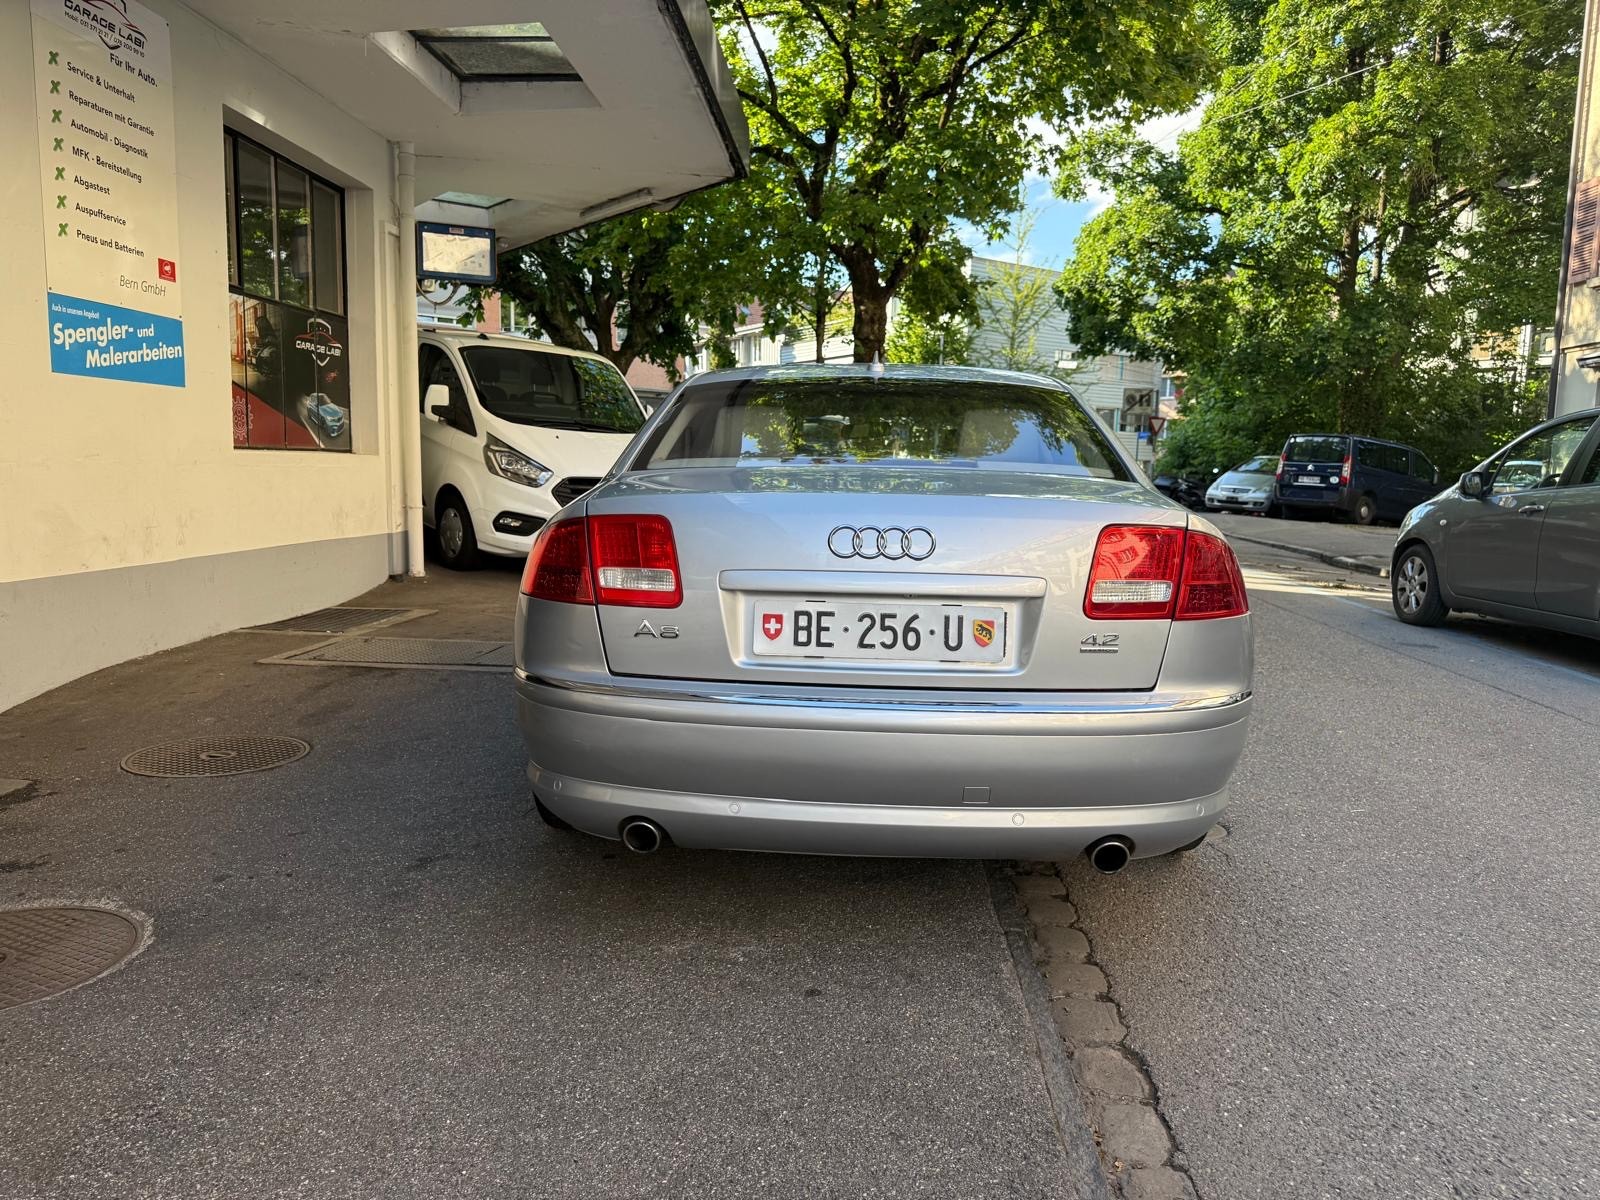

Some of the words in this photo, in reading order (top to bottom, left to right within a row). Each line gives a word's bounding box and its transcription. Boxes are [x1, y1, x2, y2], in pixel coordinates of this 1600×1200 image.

[64, 0, 116, 33] GARAGE
[118, 27, 145, 49] LABI
[80, 19, 89, 28] 031
[67, 61, 94, 82] Service
[96, 75, 101, 86] &
[103, 79, 135, 103] Unterhalt
[110, 52, 123, 67] Für
[125, 61, 135, 74] Ihr
[138, 69, 157, 87] Auto.
[69, 90, 113, 117] Reparaturen
[114, 113, 126, 124] mit
[127, 117, 154, 136] Garantie
[71, 119, 108, 142] Automobil
[114, 137, 148, 159] Diagnostik
[72, 146, 90, 161] MFK
[96, 155, 142, 183] Bereitstellung
[74, 175, 110, 195] Abgastest
[75, 202, 126, 226] Auspuffservice
[76, 229, 98, 244] Pneus
[99, 238, 113, 248] und
[114, 241, 144, 257] Batterien
[119, 275, 138, 290] Bern
[141, 280, 166, 296] GmbH
[53, 317, 134, 350] Spengler-
[137, 323, 154, 338] und
[85, 341, 182, 369] Malerarbeiten
[633, 618, 679, 639] A8
[793, 610, 836, 648] BE
[857, 613, 922, 652] 256
[943, 614, 964, 652] U
[1080, 632, 1120, 647] 4.2
